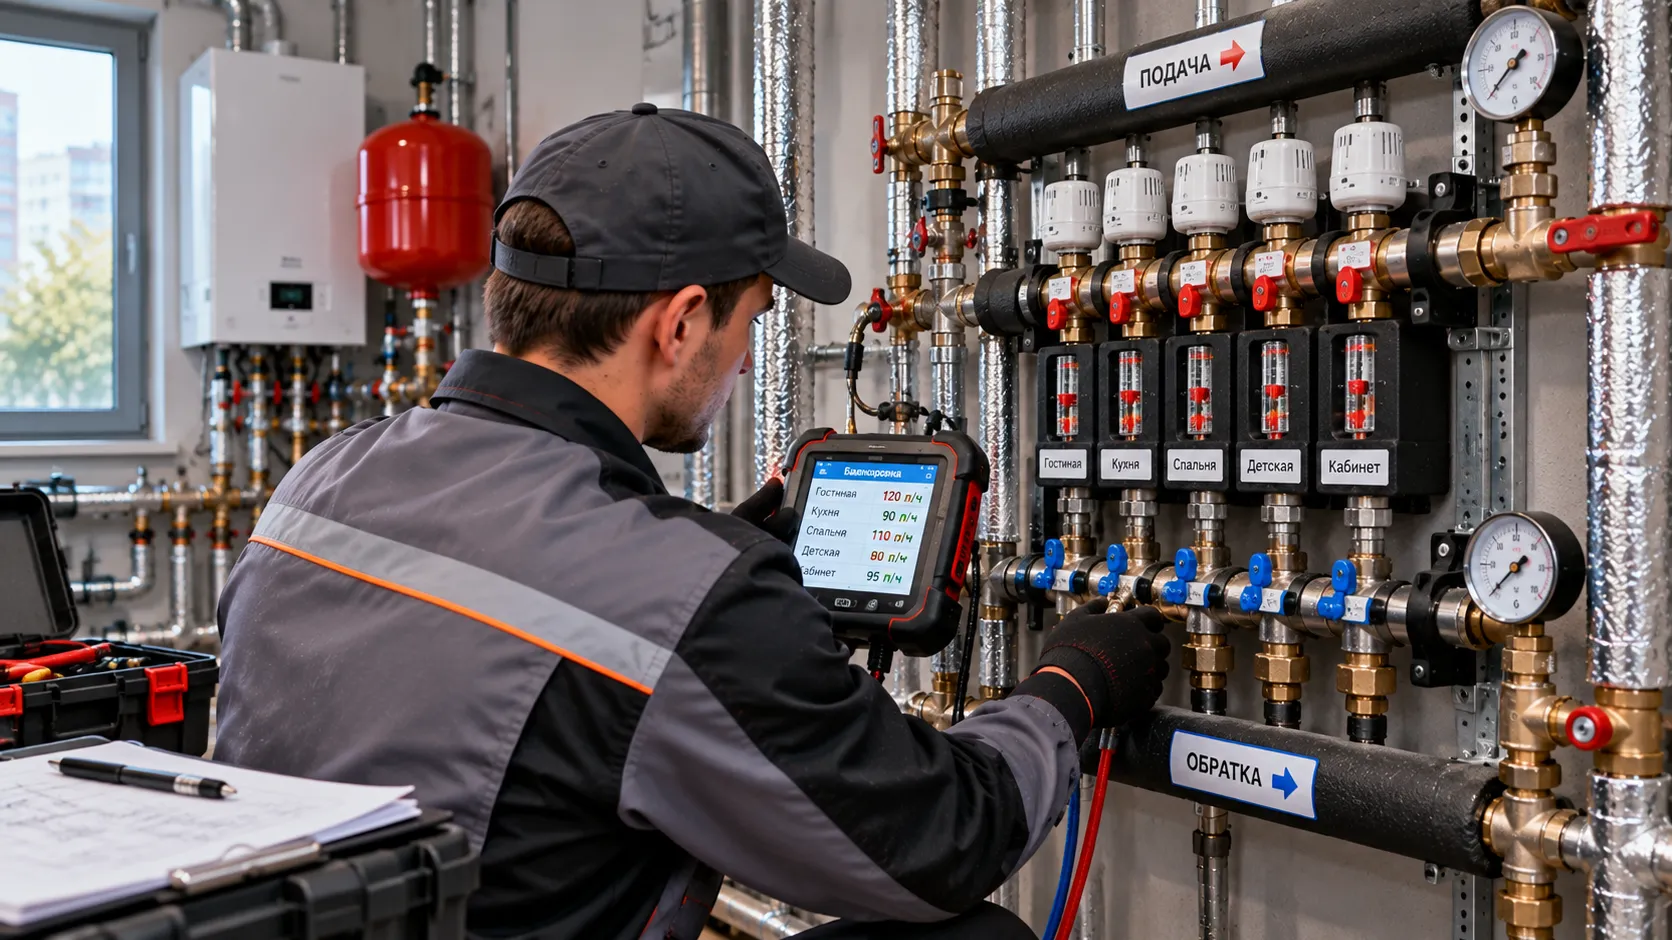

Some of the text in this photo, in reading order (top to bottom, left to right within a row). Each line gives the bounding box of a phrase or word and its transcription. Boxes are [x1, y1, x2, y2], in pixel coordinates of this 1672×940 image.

[1140, 53, 1211, 88] ПОДАЧА
[1044, 457, 1082, 469] Гостиная
[1111, 458, 1140, 471] Кухня
[1173, 458, 1217, 471] Спальня
[1247, 459, 1294, 473] Детская
[1328, 460, 1381, 474] Кабинет
[883, 490, 901, 502] 120
[811, 506, 840, 518] Кухня
[882, 510, 896, 522] 90
[872, 529, 891, 541] 110
[801, 545, 841, 558] Детская
[870, 550, 884, 562] 80
[866, 571, 880, 582] 95
[1186, 752, 1262, 787] ОБРАТКА
